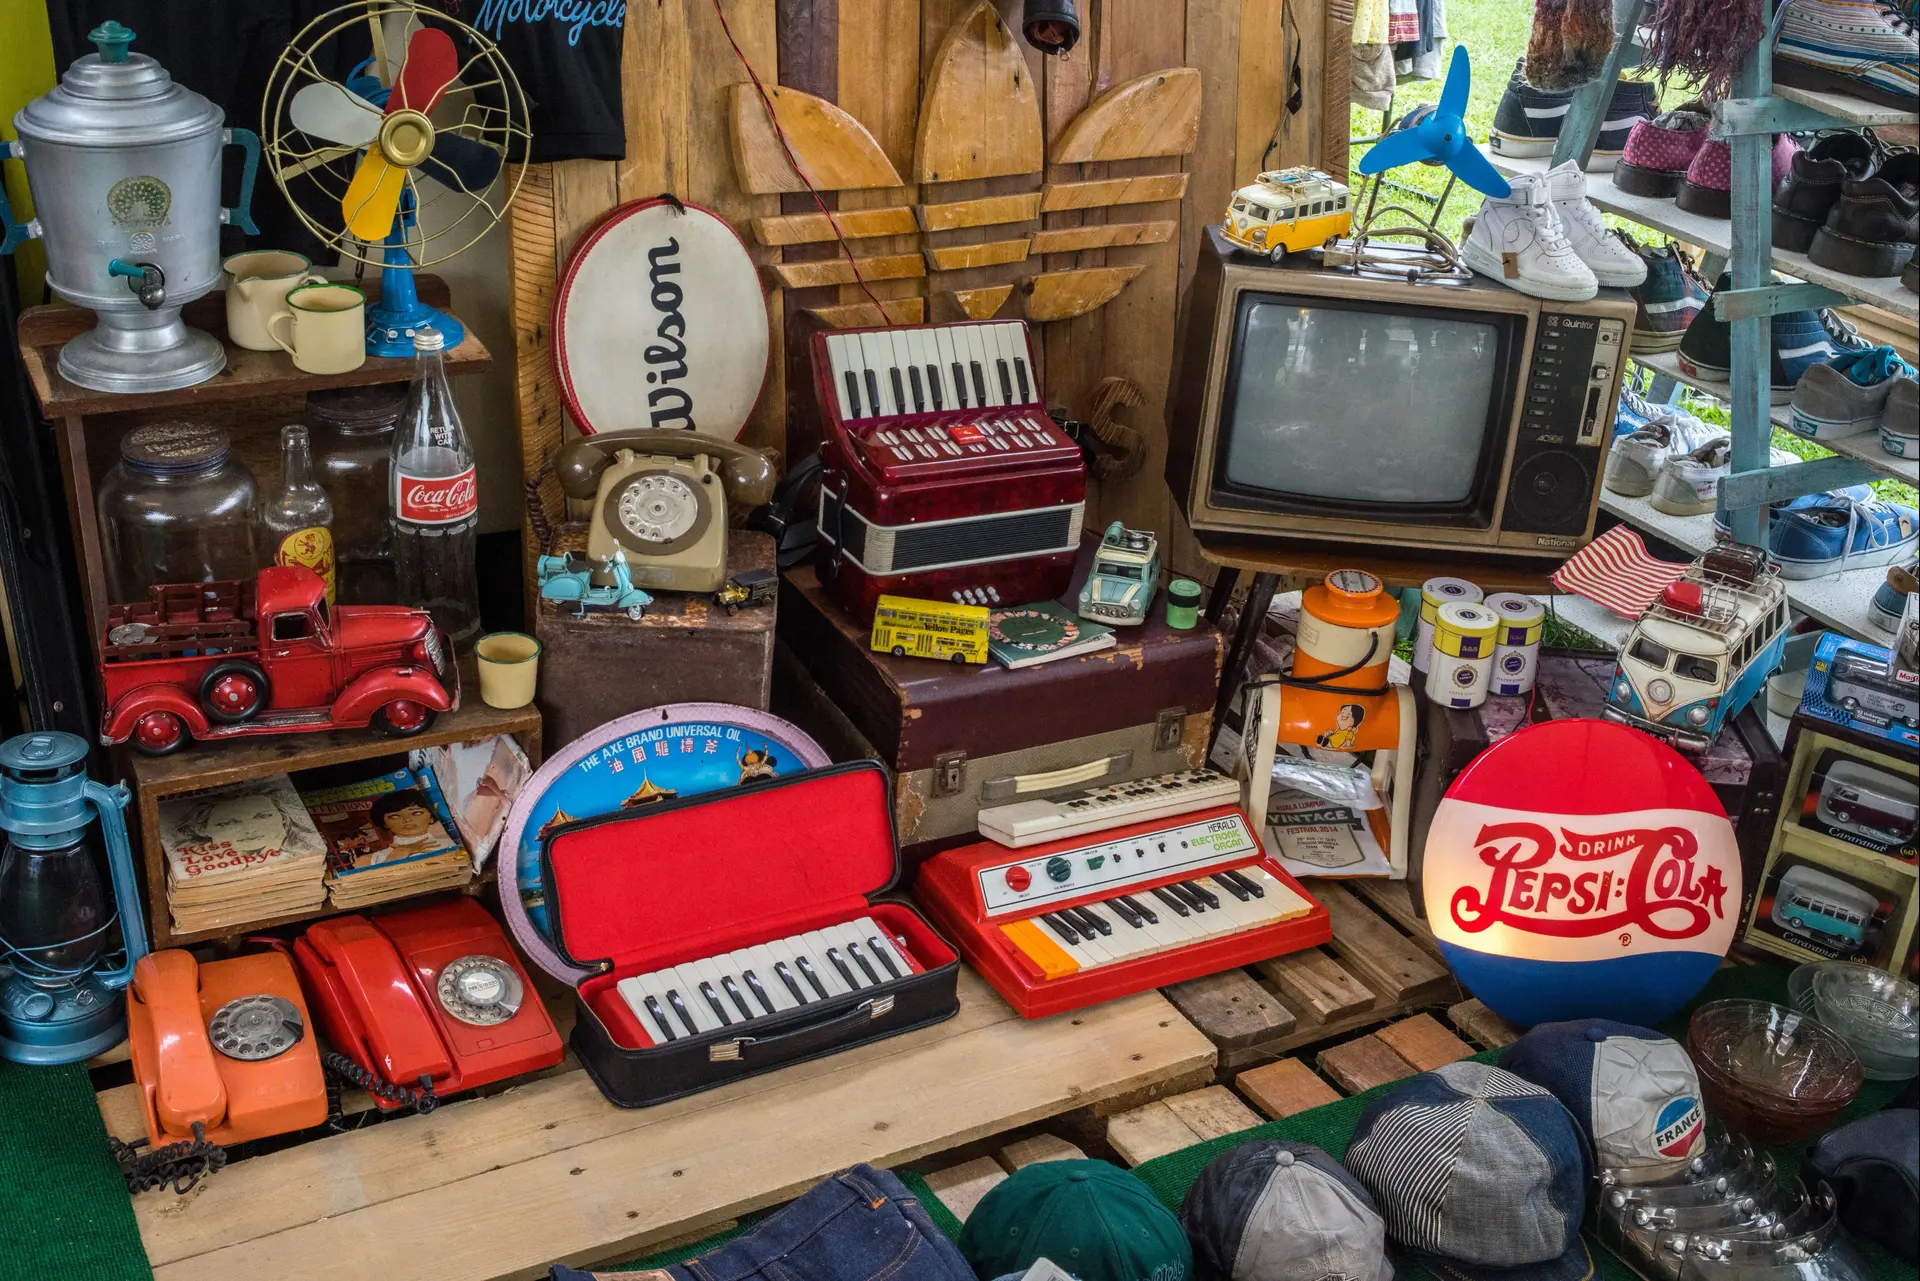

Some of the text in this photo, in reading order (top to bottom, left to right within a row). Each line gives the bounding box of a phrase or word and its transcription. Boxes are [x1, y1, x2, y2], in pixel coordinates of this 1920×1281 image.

[1563, 319, 1594, 330] Quintrix
[644, 236, 696, 431] Wilson
[407, 474, 475, 509] Coca-Cola
[1538, 537, 1576, 547] National
[924, 623, 949, 633] Yellow
[950, 625, 975, 636] Pages
[579, 724, 742, 773] THE AXE BRAND UNIVERSAL OIL
[1276, 801, 1326, 811] KUALA LUMPUR
[1267, 810, 1349, 823] VINTAGE
[1207, 820, 1237, 833] HERALD
[1286, 827, 1319, 835] FESTIVAL
[1191, 828, 1241, 847] ELECTRONIC
[1213, 838, 1244, 851] ORGAN
[1578, 834, 1636, 857] DRINK
[1829, 827, 1887, 852] Cararama
[177, 841, 232, 856] Kiss
[180, 848, 238, 865] Love
[185, 848, 281, 876] Goodbye
[1656, 1106, 1700, 1147] FRANCE
